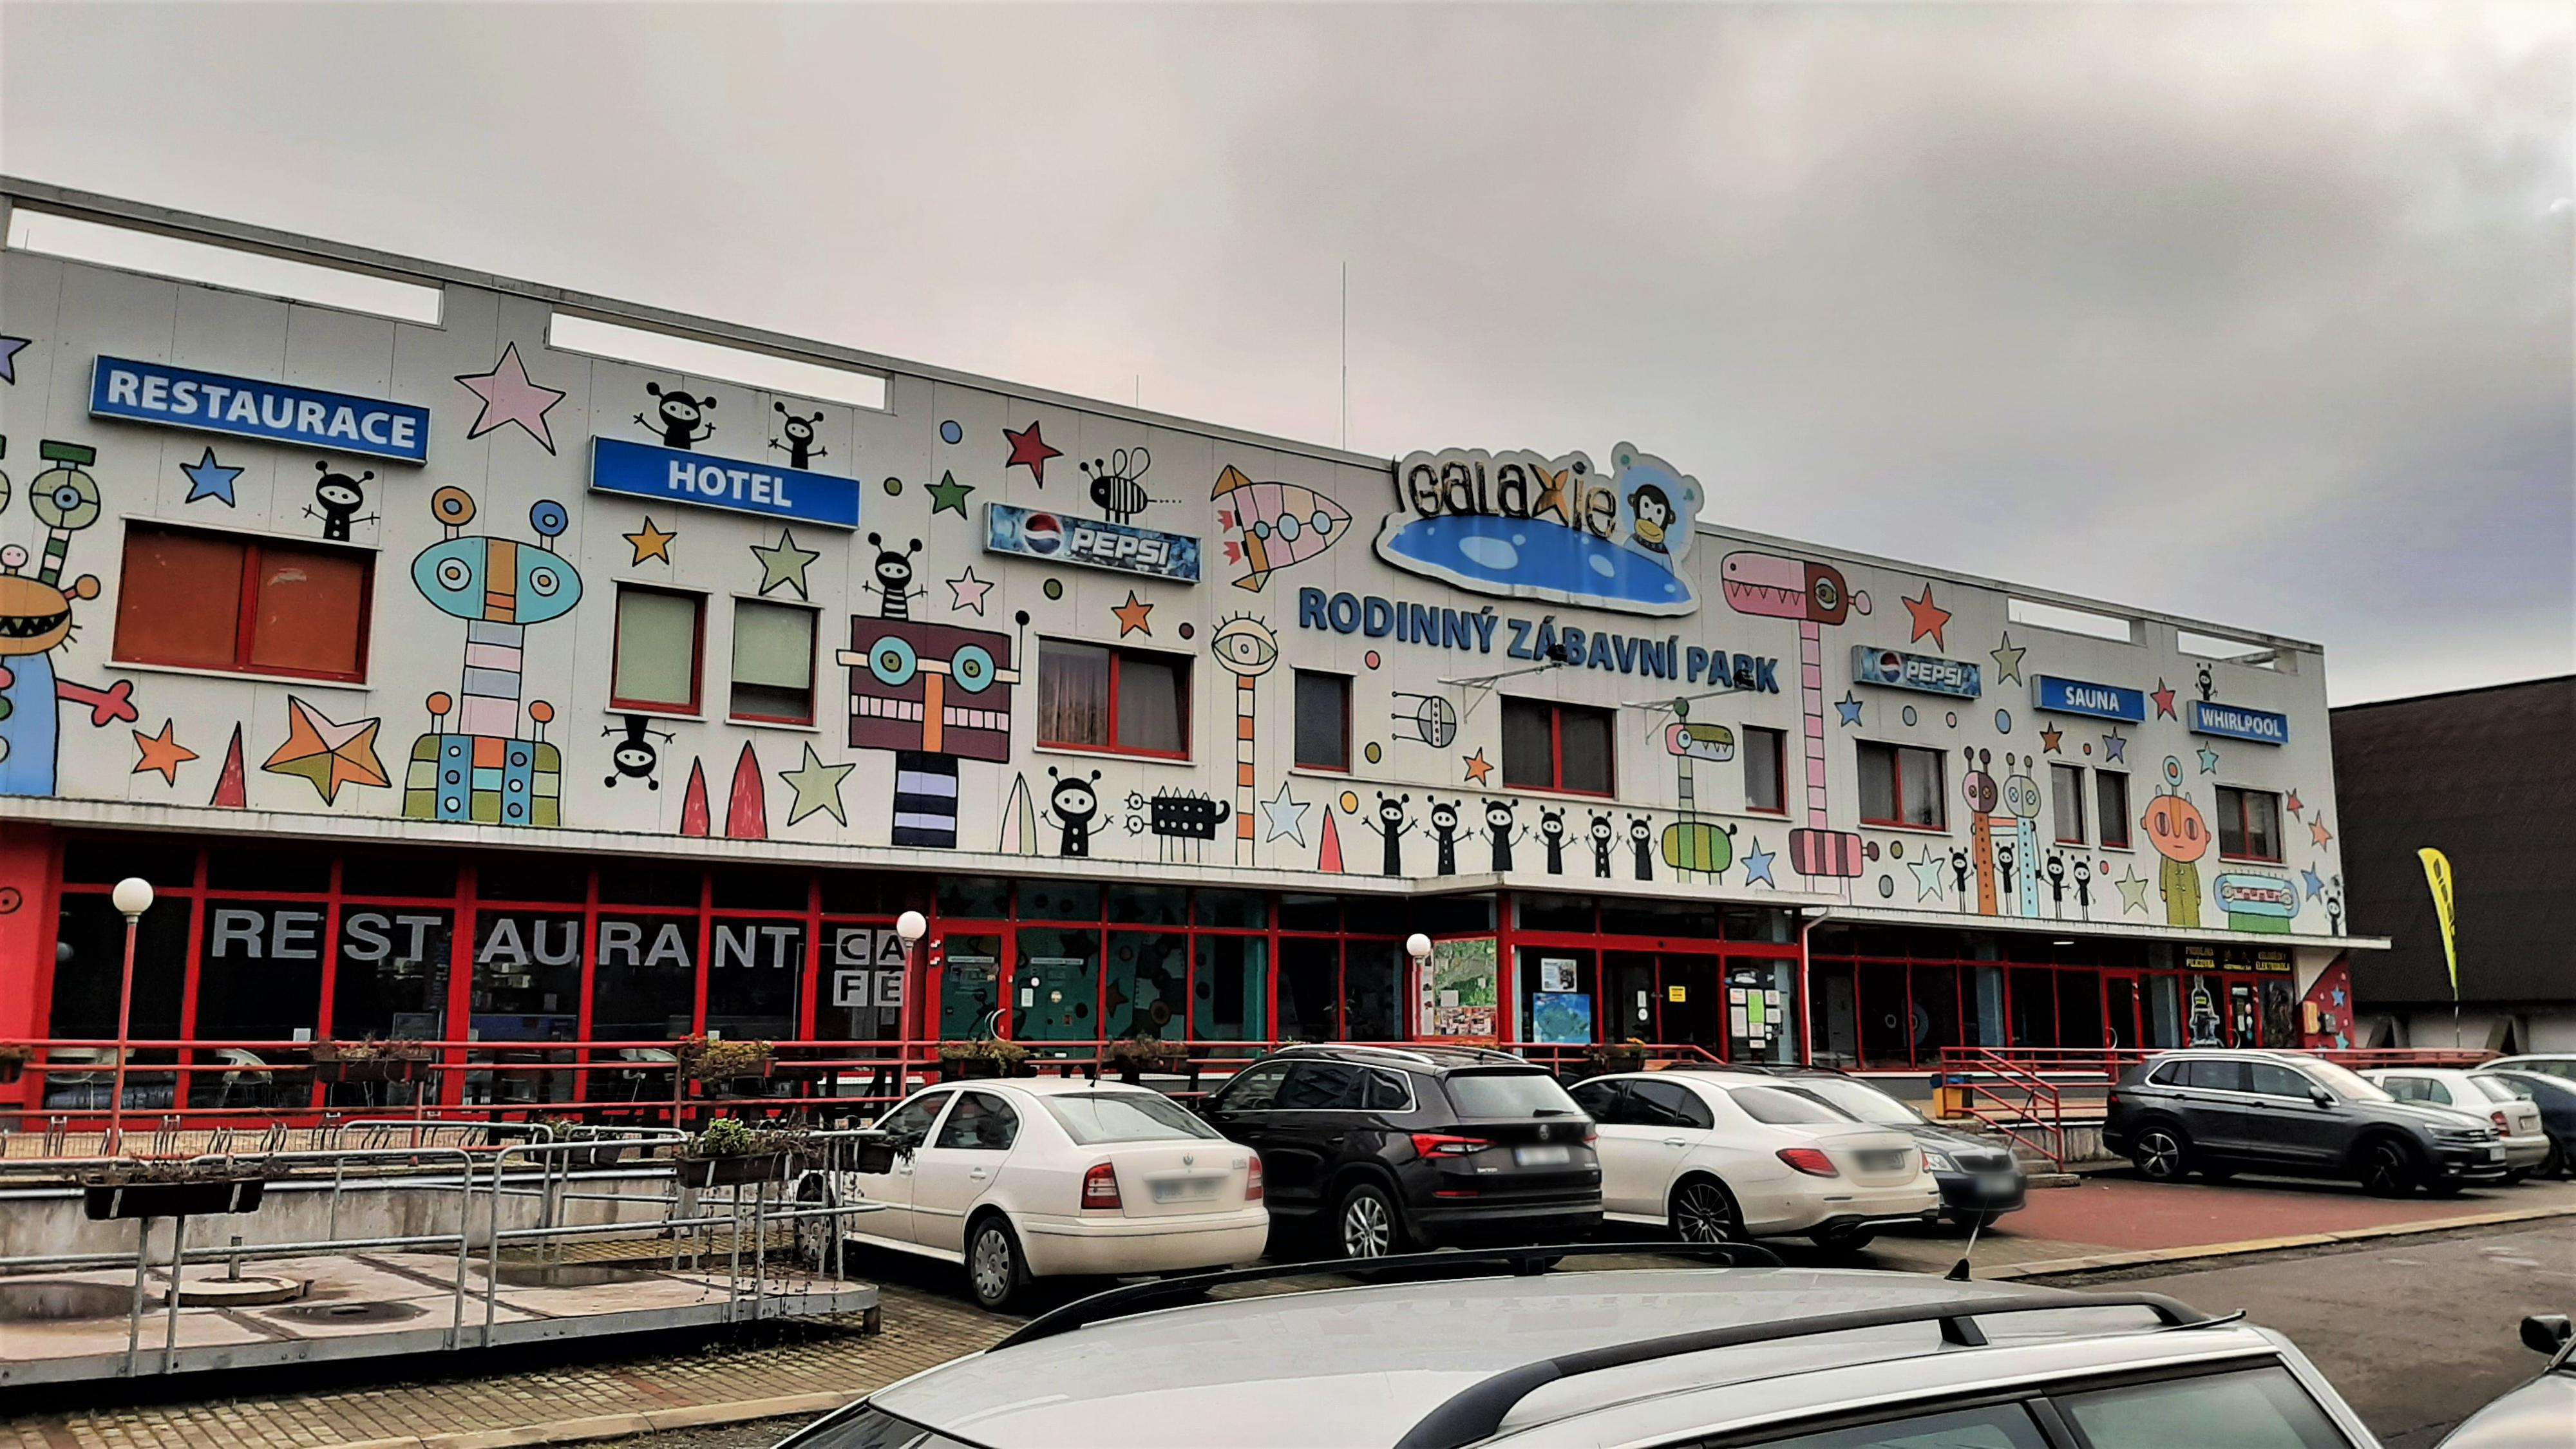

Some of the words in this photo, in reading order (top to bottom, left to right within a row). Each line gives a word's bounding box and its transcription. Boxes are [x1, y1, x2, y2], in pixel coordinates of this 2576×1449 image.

[106, 370, 417, 449] RESTAURACE
[668, 460, 792, 507] HOTEL
[1070, 527, 1171, 565] PEPSI
[1299, 587, 1499, 654] RODINNÝ
[1507, 616, 1680, 679] ZÁBAVNÍ
[1687, 646, 1780, 694] PARK
[1906, 661, 1962, 687] PEPSI
[2065, 685, 2121, 712] SAUNA
[2200, 708, 2283, 737] WHIRLPOOL
